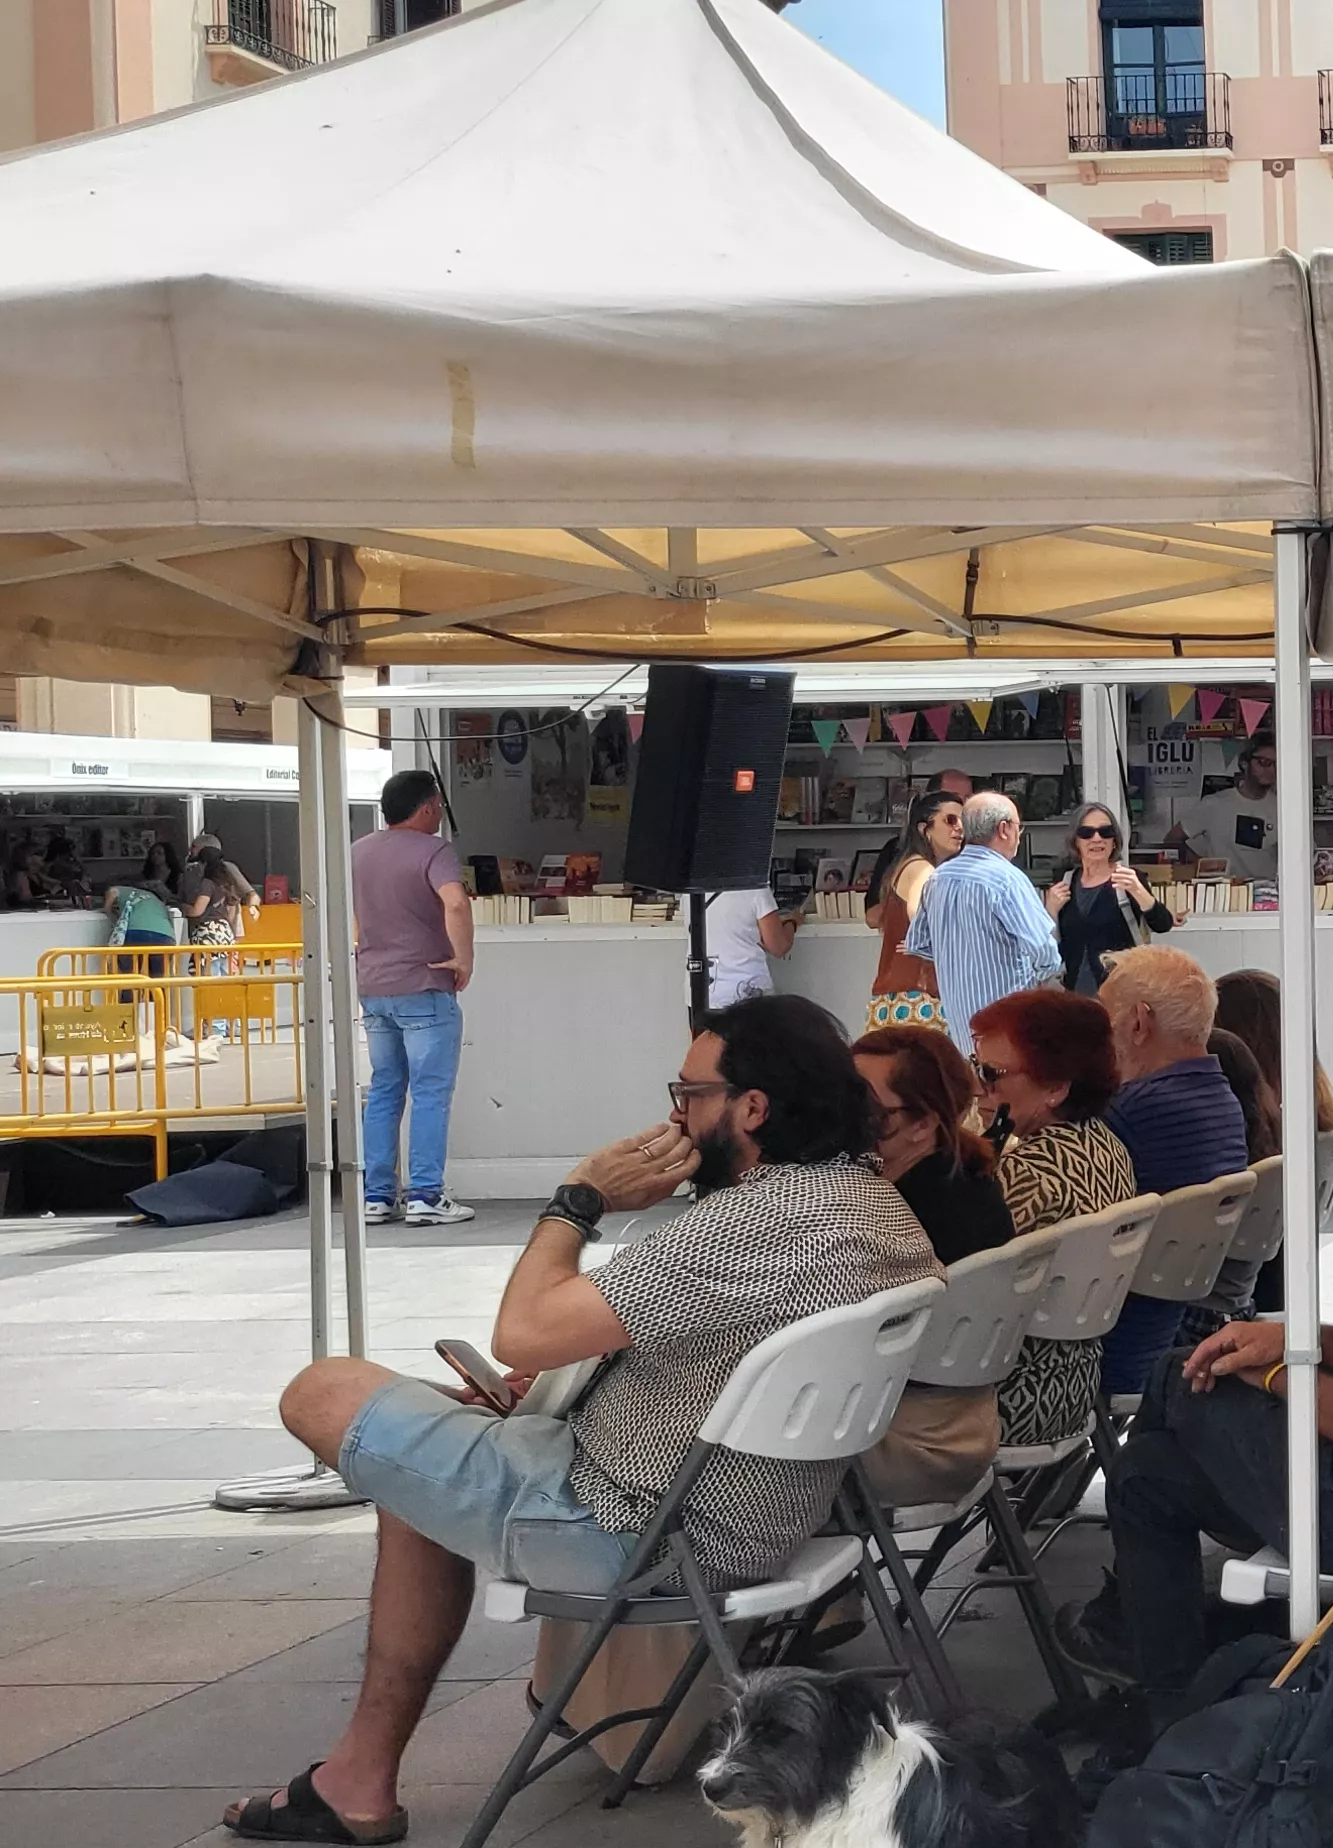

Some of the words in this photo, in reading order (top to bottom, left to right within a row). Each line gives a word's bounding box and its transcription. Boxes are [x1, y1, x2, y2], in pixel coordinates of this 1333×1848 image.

[1147, 726, 1158, 741] EL
[88, 763, 109, 776] editor
[266, 768, 291, 780] Editorial
